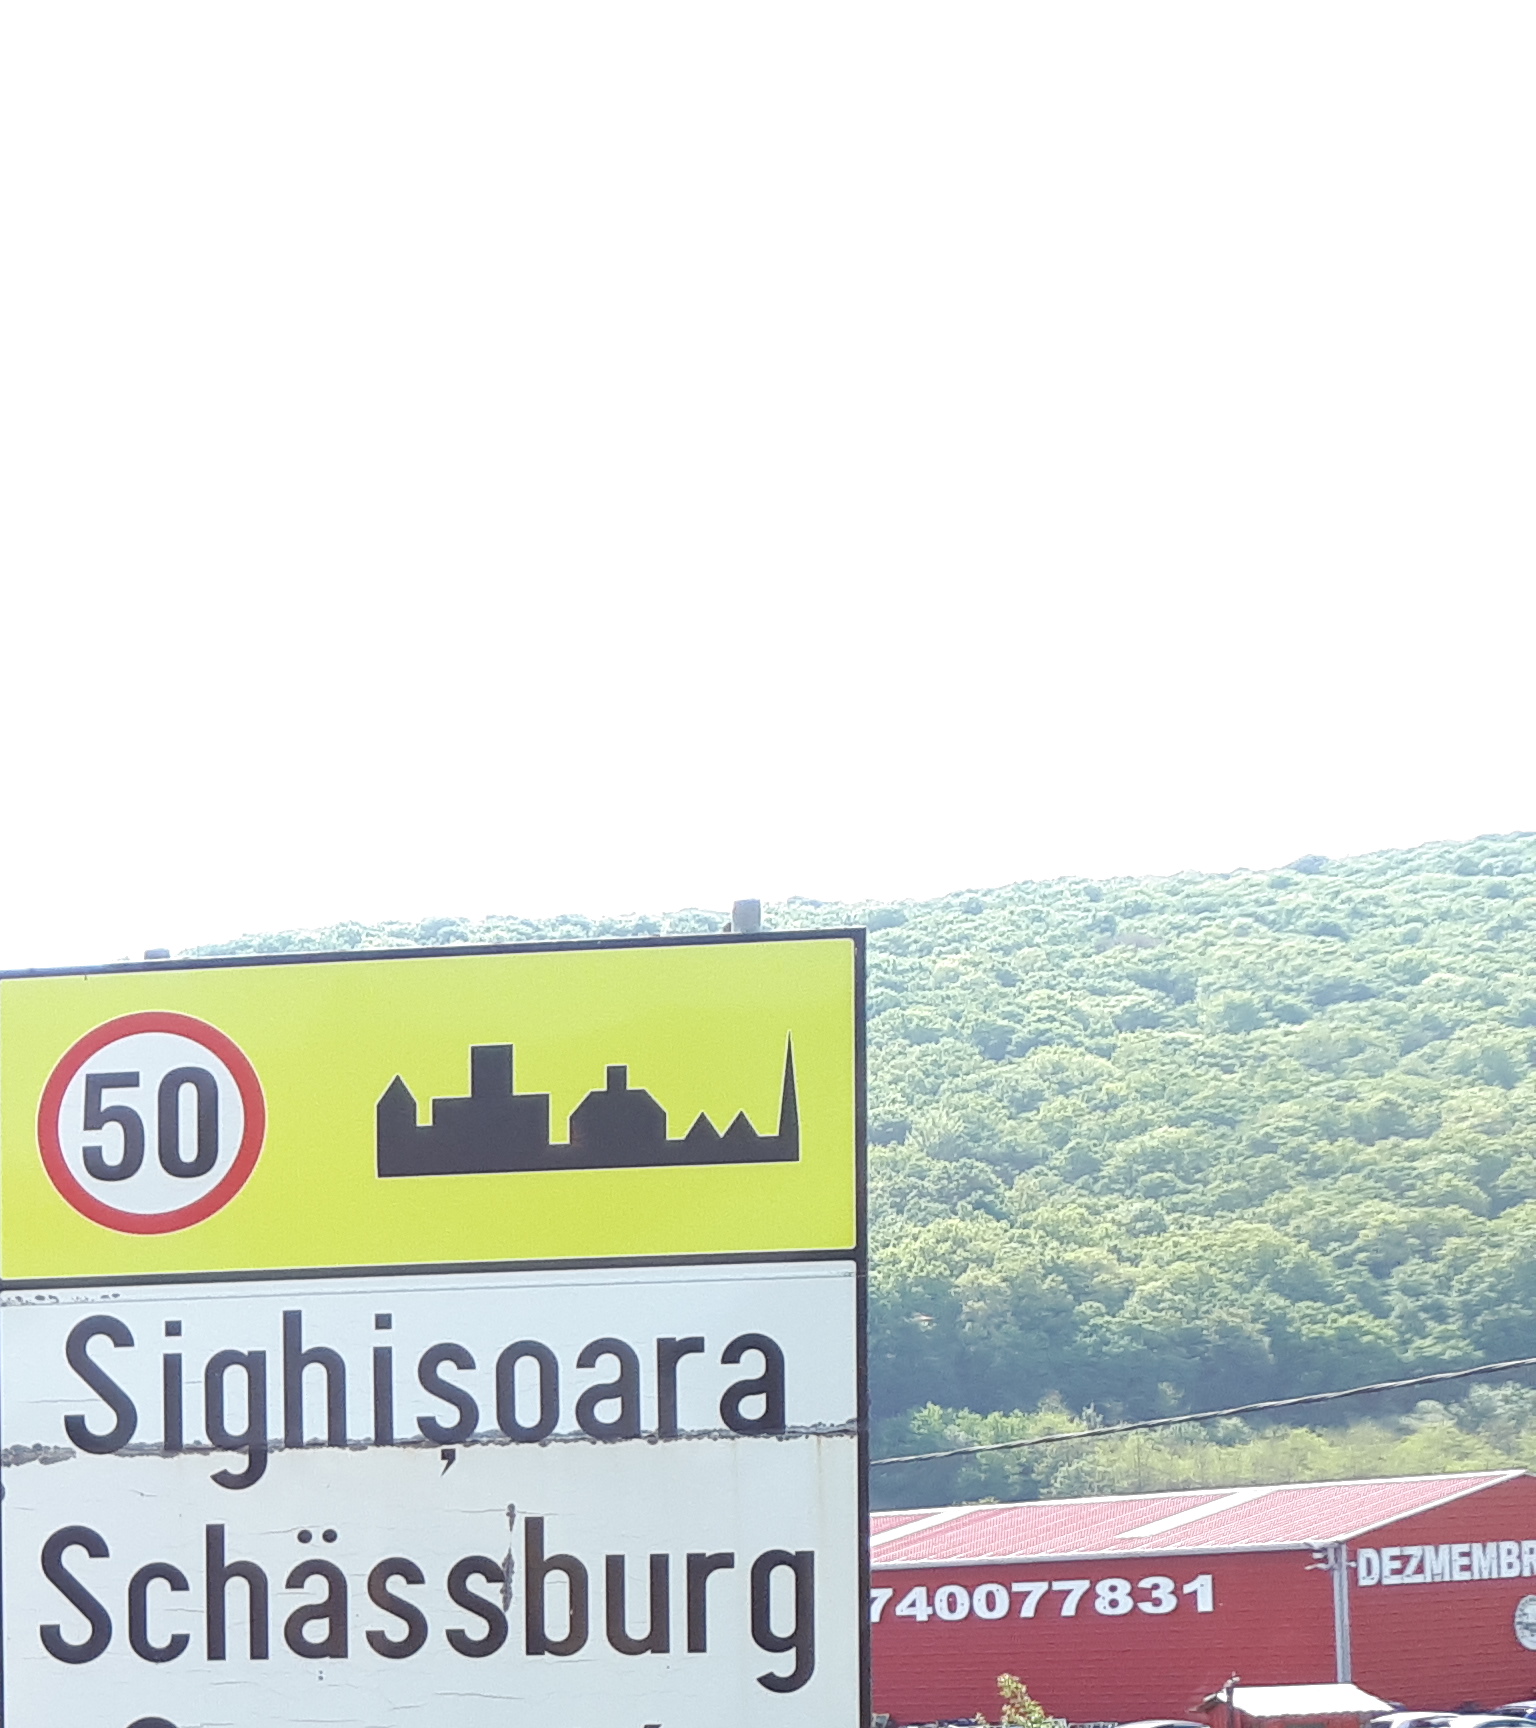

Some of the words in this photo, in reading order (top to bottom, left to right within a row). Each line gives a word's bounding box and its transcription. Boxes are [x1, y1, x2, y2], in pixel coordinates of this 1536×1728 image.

[81, 1066, 220, 1183] 50
[63, 1309, 787, 1491] Sighișoara
[39, 1516, 817, 1694] Schässburg
[870, 1574, 1215, 1623] 740077831
